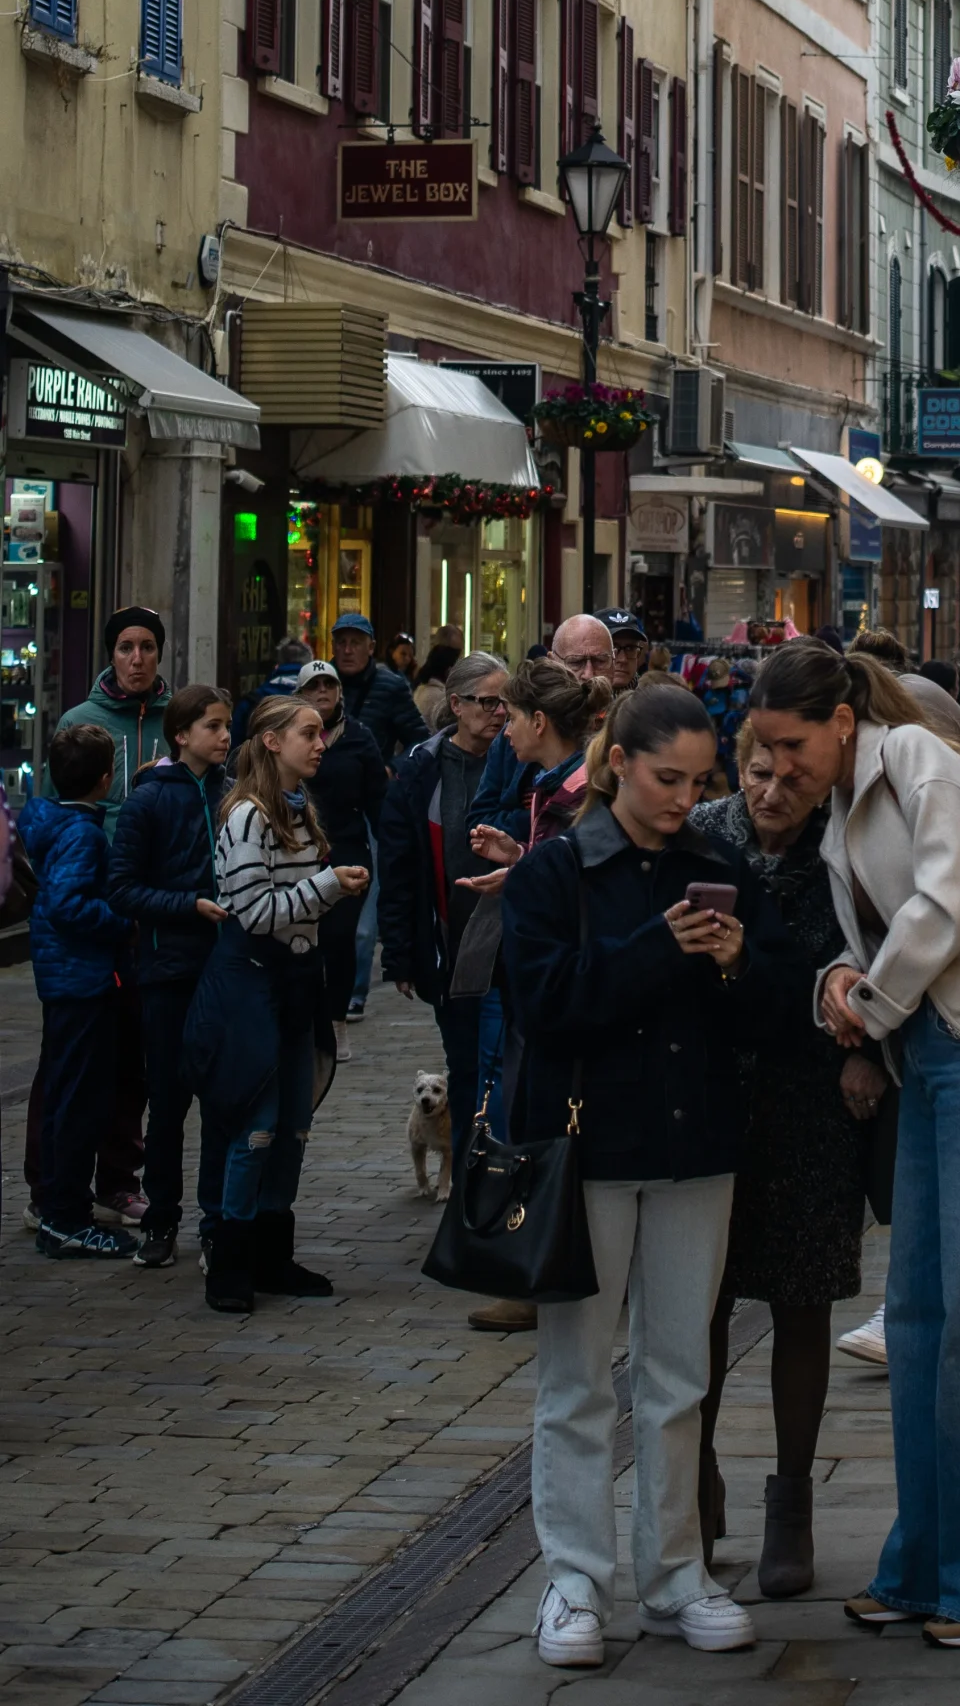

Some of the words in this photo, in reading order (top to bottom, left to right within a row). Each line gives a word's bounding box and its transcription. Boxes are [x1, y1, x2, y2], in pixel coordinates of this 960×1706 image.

[386, 160, 428, 179] THE
[345, 184, 419, 203] JEWEL
[425, 183, 469, 202] BOX
[28, 366, 76, 406] PURPLE
[76, 376, 106, 411] RAIN
